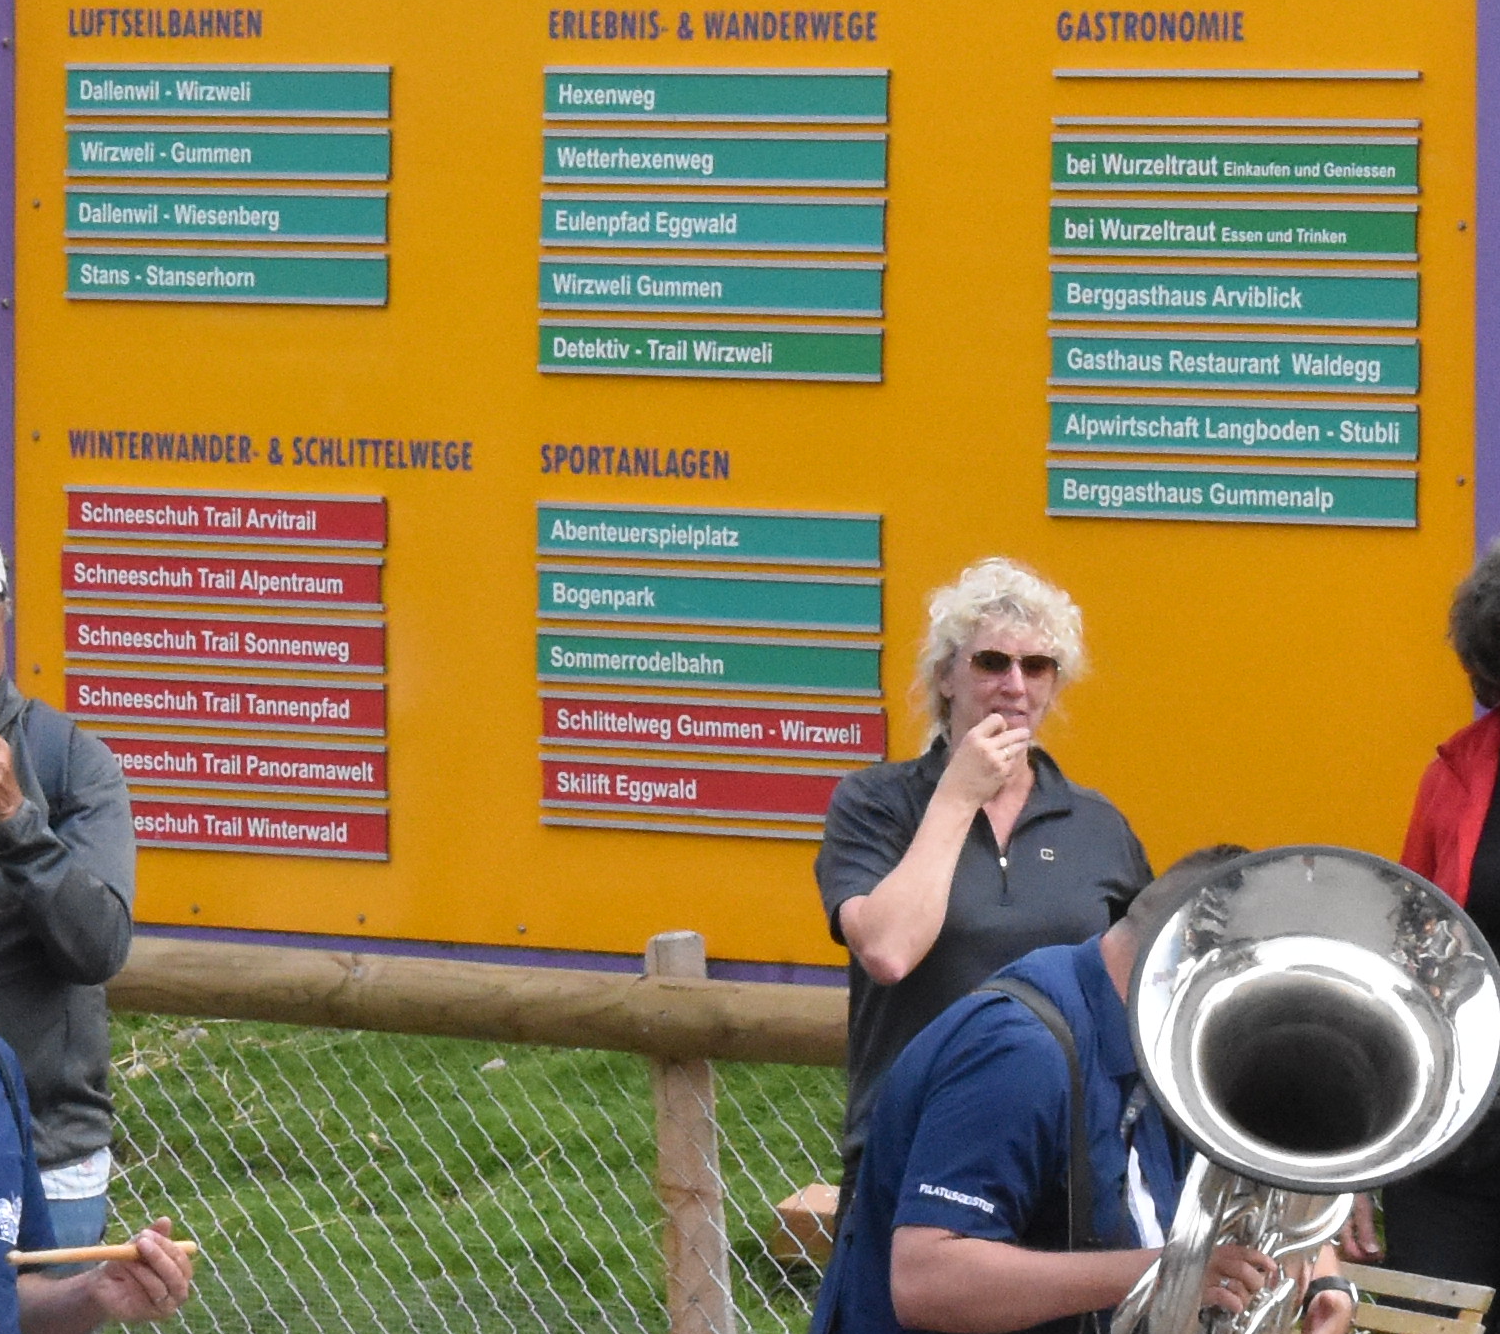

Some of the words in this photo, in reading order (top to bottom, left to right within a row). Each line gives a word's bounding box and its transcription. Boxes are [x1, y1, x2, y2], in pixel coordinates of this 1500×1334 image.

[69, 9, 262, 38] LUFTSEILBAHNEN
[549, 10, 668, 39] ERLEBNIS-
[677, 12, 693, 40] &
[705, 11, 877, 41] WANDERWEGE
[1057, 11, 1243, 42] GASTRONOMIE
[80, 80, 159, 101] Dallenwil
[176, 81, 250, 102] Wirzweli
[559, 84, 655, 110] Hexenweg
[81, 142, 154, 162] Wirzweli
[171, 143, 251, 163] Gummen
[557, 147, 714, 174] Wetterhexenweg
[1066, 153, 1096, 175] bei
[1102, 154, 1218, 176] Wurzeltraut
[1224, 162, 1290, 177] Einkaufen
[1295, 163, 1320, 178] und
[1324, 164, 1395, 179] Geniessen
[79, 203, 157, 223] Dallenwil
[175, 204, 280, 231] Wiesenberg
[555, 211, 649, 237] Eulenpfad
[656, 212, 737, 238] Eggwald
[1065, 219, 1094, 240] bei
[1101, 220, 1216, 242] Wurzeltraut
[1222, 228, 1262, 243] Essen
[1267, 229, 1292, 243] und
[1296, 229, 1346, 244] Trinken
[81, 264, 129, 285] Stans
[147, 266, 255, 287] Stanserhorn
[553, 273, 630, 295] Wirzweli
[637, 275, 721, 298] Gummen
[1067, 283, 1206, 310] Berggasthaus
[1212, 285, 1302, 309] Arviblick
[553, 337, 629, 359] Detektiv
[648, 339, 687, 360] Trail
[693, 341, 772, 363] Wirzweli
[1068, 348, 1161, 372] Gasthaus
[1169, 351, 1280, 375] Restaurant
[1292, 354, 1380, 382] Waldegg
[1065, 414, 1199, 440] Alpwirtschaft
[1205, 418, 1319, 445] Langboden
[1340, 421, 1400, 443] Stubli
[69, 429, 258, 462] WINTERWANDER-
[268, 436, 283, 465] &
[293, 437, 473, 471] SCHLITTELWEGE
[541, 444, 730, 479] SPORTANLAGEN
[1064, 479, 1202, 506] Berggasthaus
[1210, 483, 1333, 512] Gummenalp
[81, 502, 198, 527] Schneeschuh
[204, 506, 241, 528] Trail
[246, 509, 316, 531] Arvitrail
[551, 520, 739, 549] Abenteuerspielplatz
[74, 563, 192, 587] Schneeschuh
[198, 567, 235, 590] Trail
[240, 571, 343, 595] Alpentraum
[553, 584, 655, 610] Bogenpark
[78, 625, 196, 649] Schneeschuh
[202, 629, 239, 651] Trail
[245, 633, 349, 662] Sonnenweg
[551, 646, 723, 674] Sommerrodelbahn
[79, 686, 197, 710] Schneeschuh
[203, 690, 240, 713] Trail
[246, 693, 350, 721] Tannenpfad
[557, 709, 671, 739] Schlittelweg
[677, 715, 762, 740] Gummen
[780, 719, 861, 745] Wirzweli
[113, 750, 198, 773] neeschuh
[203, 753, 240, 775] Trail
[247, 755, 373, 782] Panoramawelt
[557, 772, 610, 794] Skilift
[617, 775, 696, 801] Eggwald
[134, 812, 199, 834] eschuh
[204, 815, 241, 837] Trail
[247, 818, 347, 843] Winterwald
